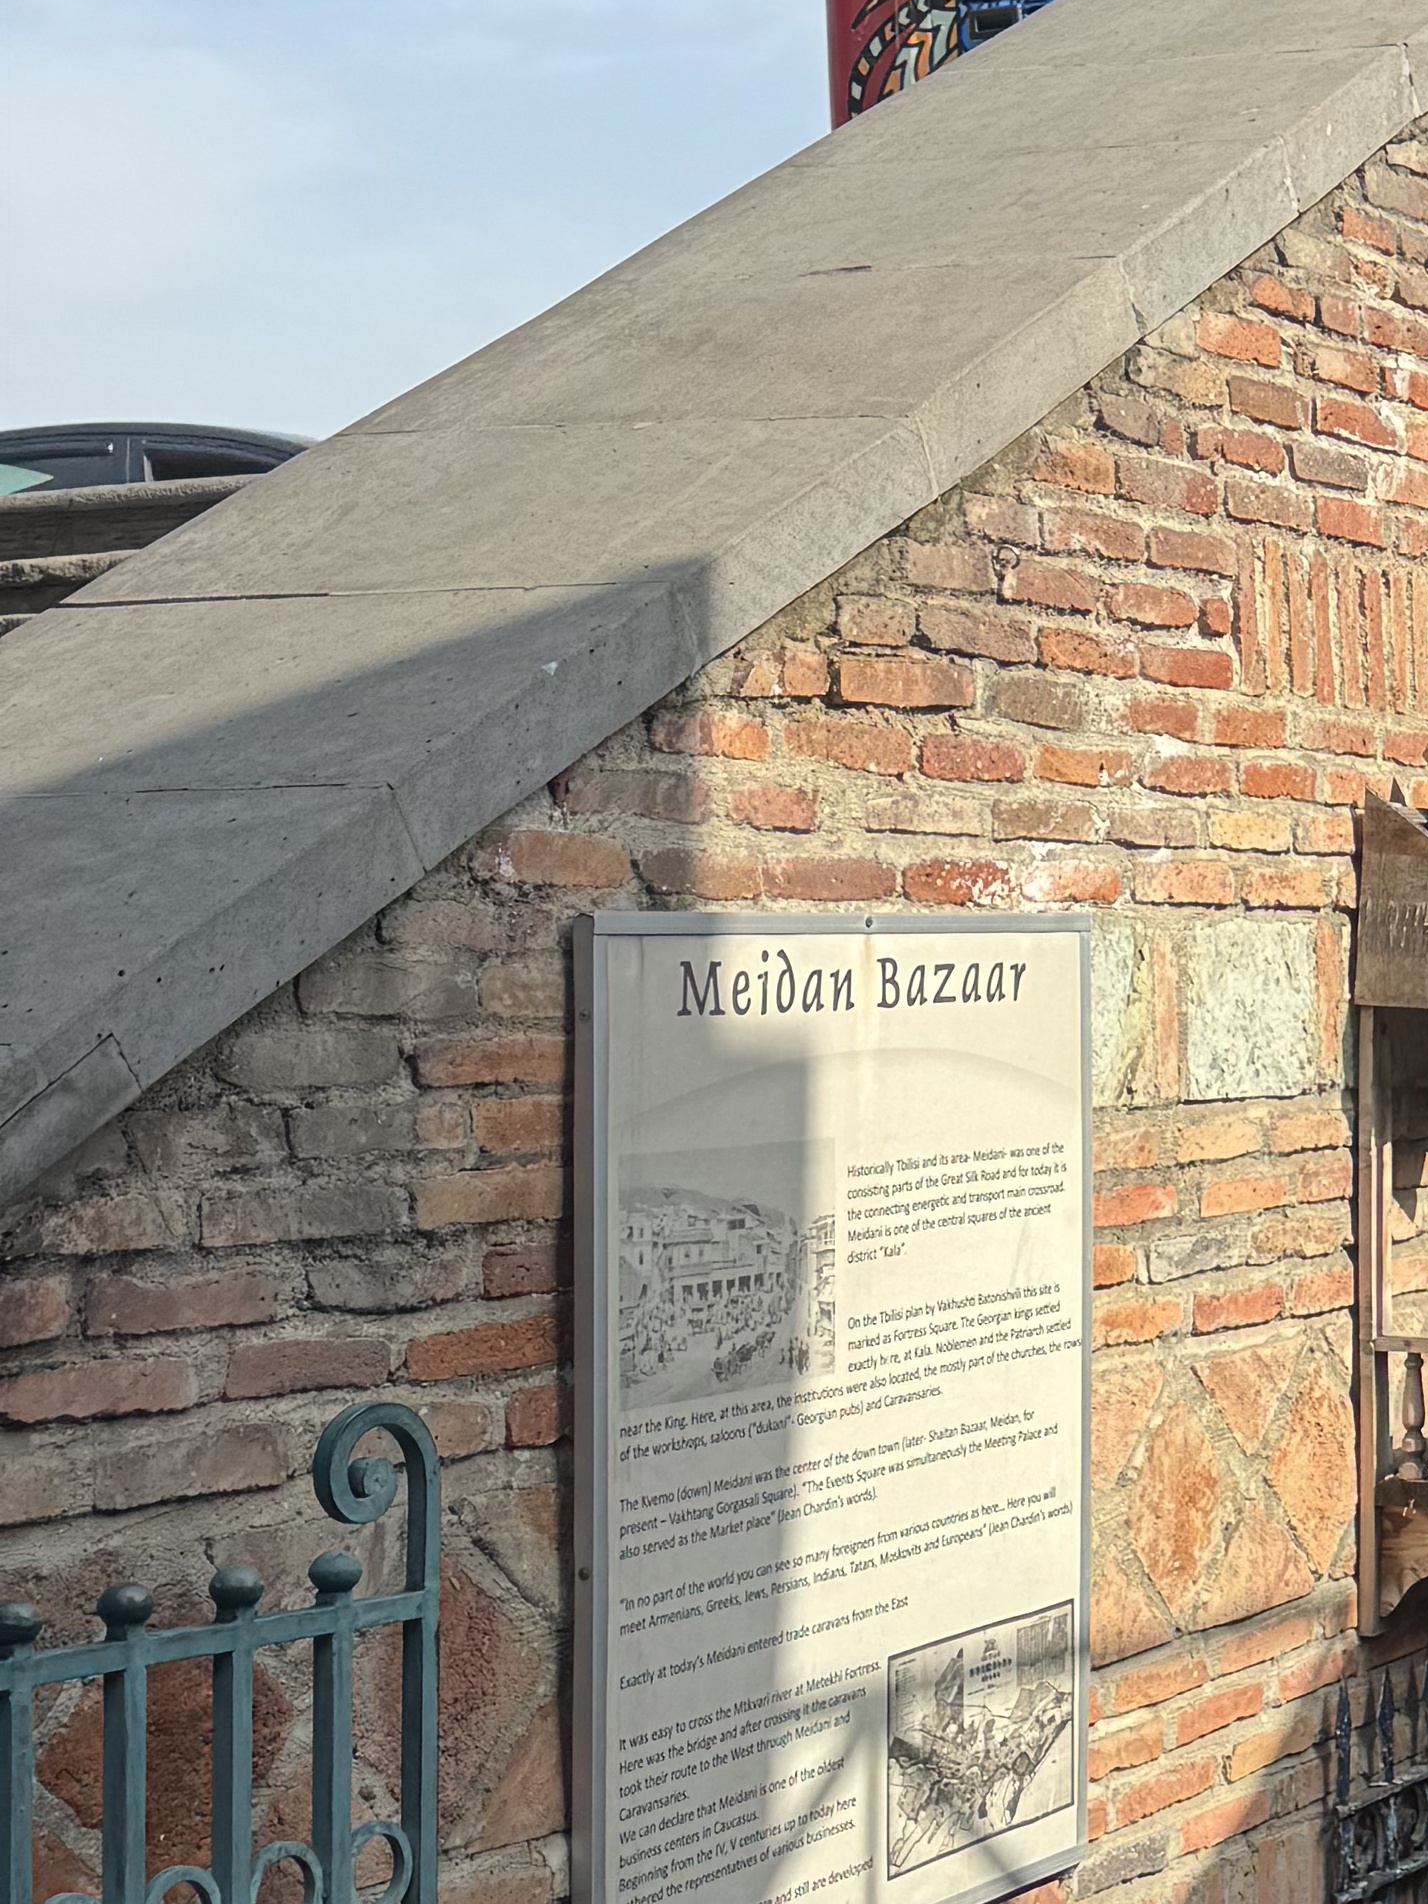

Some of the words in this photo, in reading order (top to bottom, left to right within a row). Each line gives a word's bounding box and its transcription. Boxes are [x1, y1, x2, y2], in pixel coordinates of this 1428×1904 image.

[677, 949, 855, 1017] Meidan
[877, 956, 1027, 1010] Bazaar
[846, 1249, 877, 1264] district
[847, 1227, 883, 1242] Meidani
[884, 1227, 892, 1237] is
[893, 1224, 910, 1236] one
[911, 1218, 921, 1233] of
[922, 1218, 936, 1231] the
[998, 1207, 1008, 1220] of
[1008, 1207, 1022, 1219] the
[619, 1445, 631, 1462] of
[632, 1443, 650, 1460] the
[865, 1397, 882, 1412] and
[619, 1517, 659, 1540] present
[855, 1466, 886, 1482] Square
[888, 1461, 905, 1474] was
[968, 1441, 982, 1454] the
[1043, 1423, 1058, 1437] and
[619, 1668, 655, 1691] Exactly
[656, 1666, 667, 1679] at
[706, 1645, 746, 1665] Meidani
[747, 1630, 784, 1654] entered
[785, 1625, 810, 1642] trade
[852, 1608, 873, 1623] from
[874, 1602, 890, 1616] the
[891, 1595, 909, 1611] East
[619, 1738, 627, 1752] It
[628, 1732, 649, 1749] was
[651, 1725, 674, 1742] easy
[675, 1721, 687, 1734] to
[688, 1713, 713, 1730] cross
[715, 1707, 732, 1722] the
[771, 1688, 793, 1704] river
[794, 1683, 804, 1697] at
[619, 1758, 644, 1776] Here
[645, 1751, 666, 1766] was
[667, 1744, 685, 1760] the
[686, 1734, 718, 1754] bridge
[719, 1724, 738, 1743] and
[739, 1719, 762, 1737] after
[763, 1707, 802, 1729] crossing
[811, 1699, 827, 1713] the
[619, 1778, 643, 1799] took
[644, 1771, 669, 1790] their
[670, 1764, 698, 1782] route
[699, 1759, 711, 1773] to
[712, 1753, 729, 1768] the
[730, 1743, 755, 1761] West
[756, 1730, 793, 1753] through
[795, 1720, 831, 1740] Meidani
[833, 1710, 851, 1728] and
[619, 1830, 637, 1845] We
[638, 1822, 657, 1839] can
[658, 1810, 695, 1832] declare
[696, 1801, 717, 1819] that
[719, 1785, 758, 1811] Meidani
[759, 1782, 768, 1796] is
[768, 1778, 787, 1794] one
[788, 1770, 798, 1787] of
[800, 1768, 816, 1782] the
[816, 1756, 845, 1776] oldest
[618, 1864, 669, 1893] Beginning
[670, 1856, 695, 1874] from
[696, 1849, 713, 1865] the
[729, 1837, 737, 1851] V
[738, 1824, 782, 1848] centuries
[784, 1819, 796, 1832] up
[797, 1813, 809, 1827] to
[809, 1804, 835, 1822] today
[836, 1797, 857, 1812] here
[619, 1844, 662, 1870] business
[664, 1831, 700, 1853] centers
[702, 1826, 712, 1840] in
[665, 1883, 683, 1898] the
[759, 1845, 770, 1863] of
[771, 1833, 805, 1858] various
[794, 1880, 810, 1899] still
[811, 1877, 827, 1892] are
[828, 1855, 874, 1885] developed
